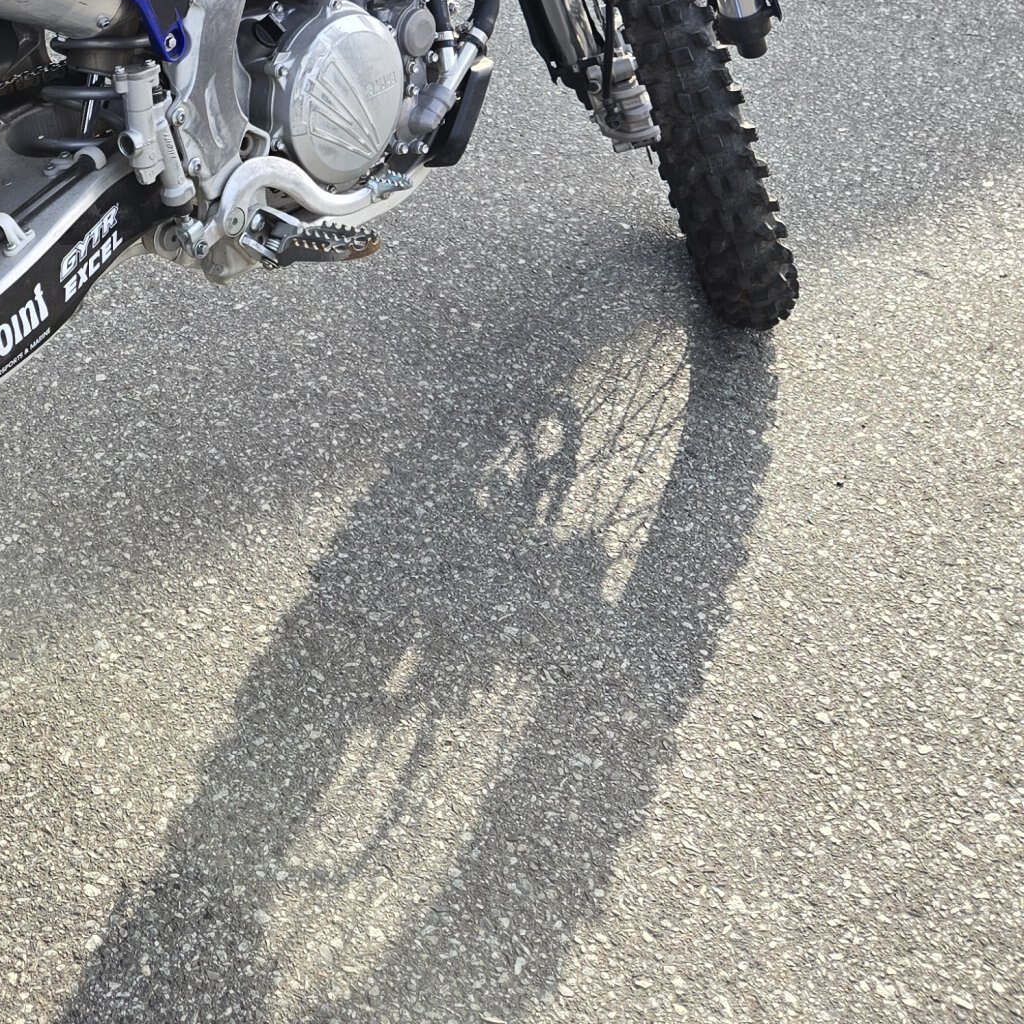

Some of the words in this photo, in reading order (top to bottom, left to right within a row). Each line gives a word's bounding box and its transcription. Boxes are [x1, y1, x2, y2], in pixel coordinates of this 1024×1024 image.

[60, 202, 120, 282] GYTR
[64, 230, 124, 303] EXCEL
[29, 326, 52, 350] MARINE
